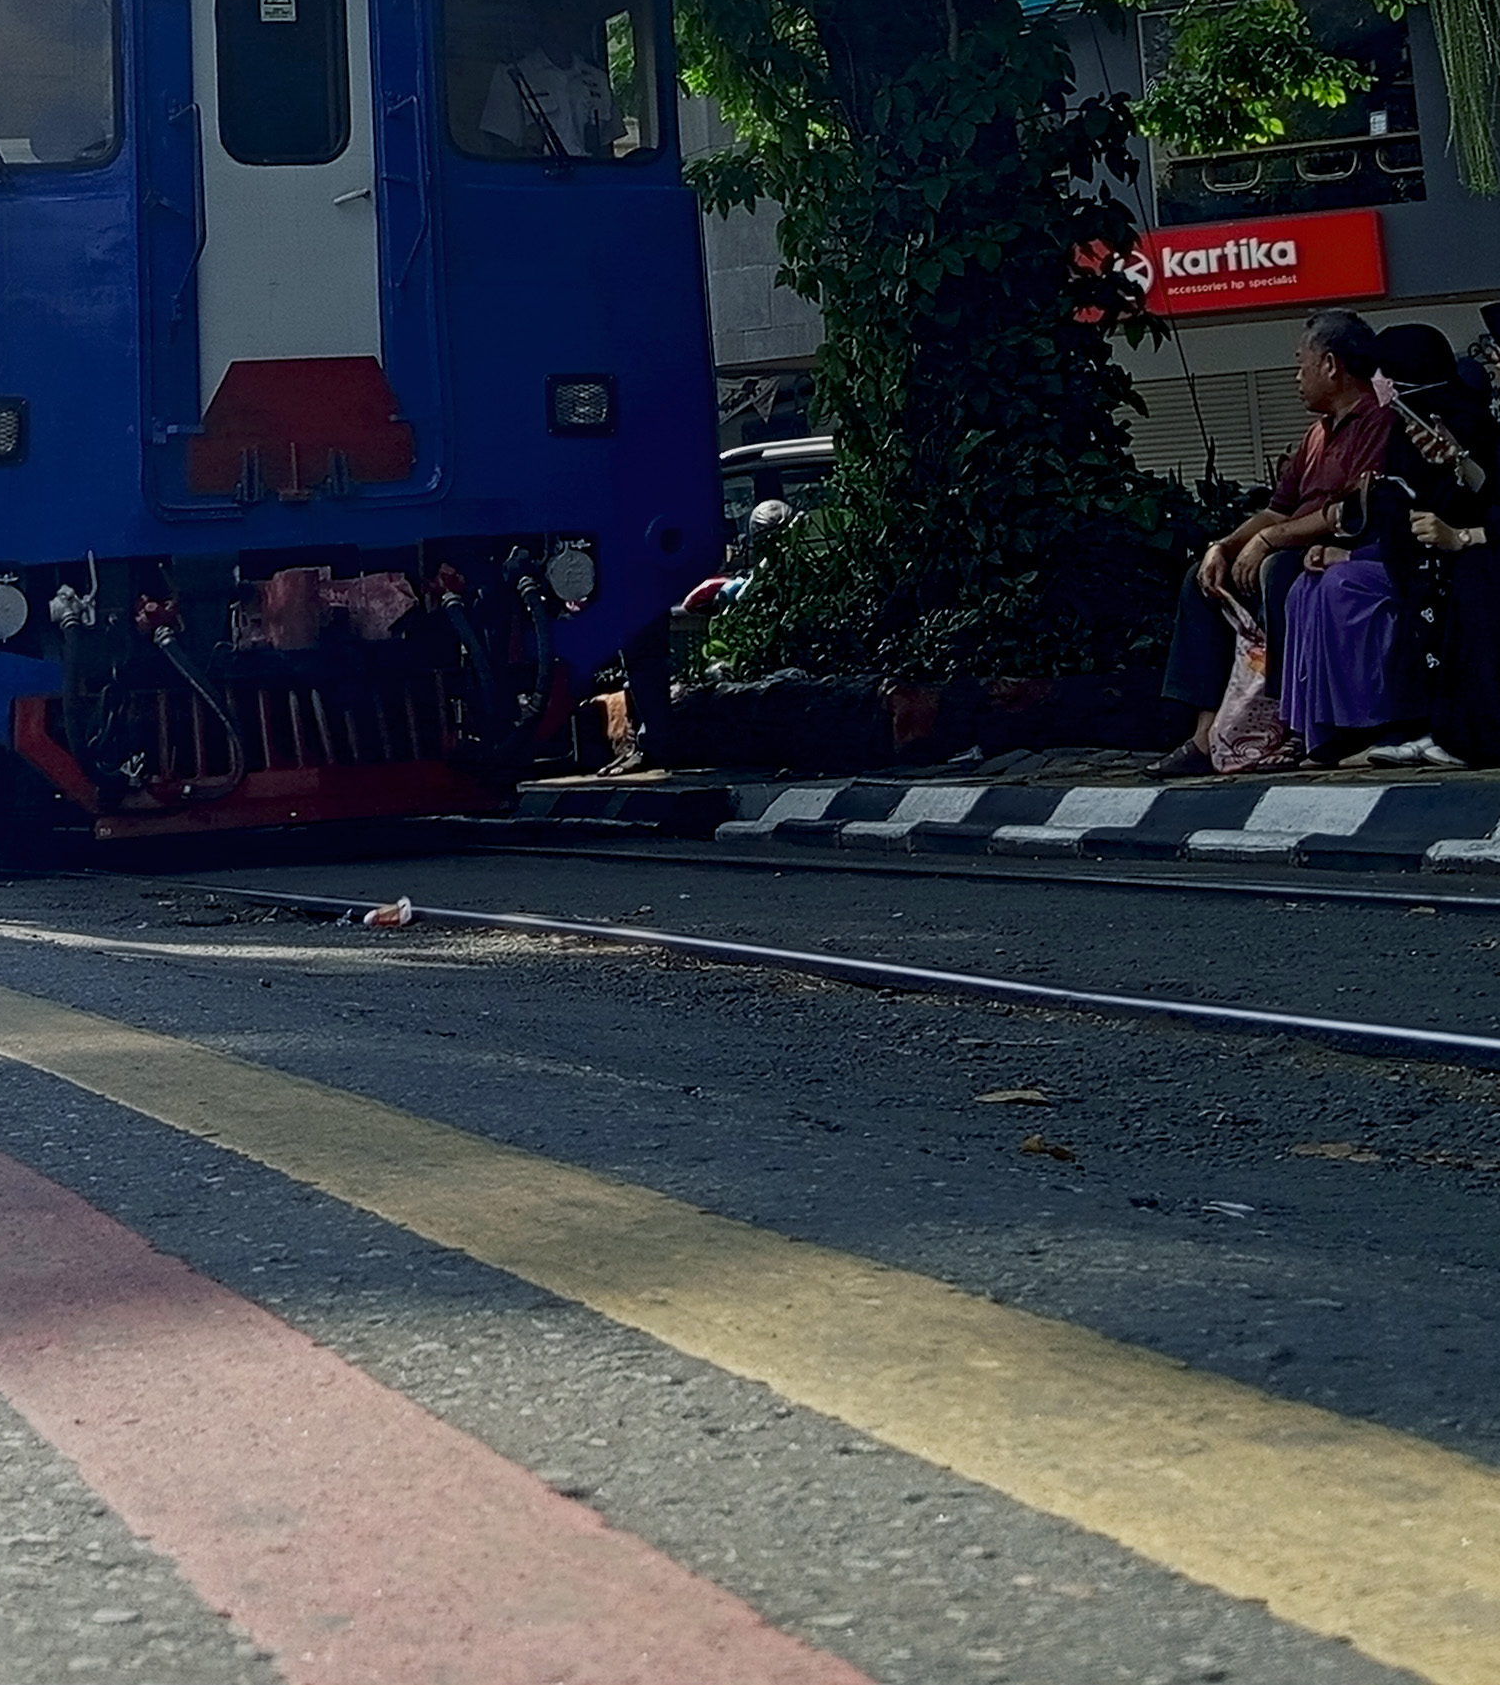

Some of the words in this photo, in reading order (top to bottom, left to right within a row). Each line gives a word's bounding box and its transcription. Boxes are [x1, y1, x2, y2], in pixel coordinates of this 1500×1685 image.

[1161, 236, 1298, 279] kartika
[1167, 280, 1228, 296] accessories
[1231, 277, 1246, 292] hp
[1248, 273, 1298, 289] specialist
